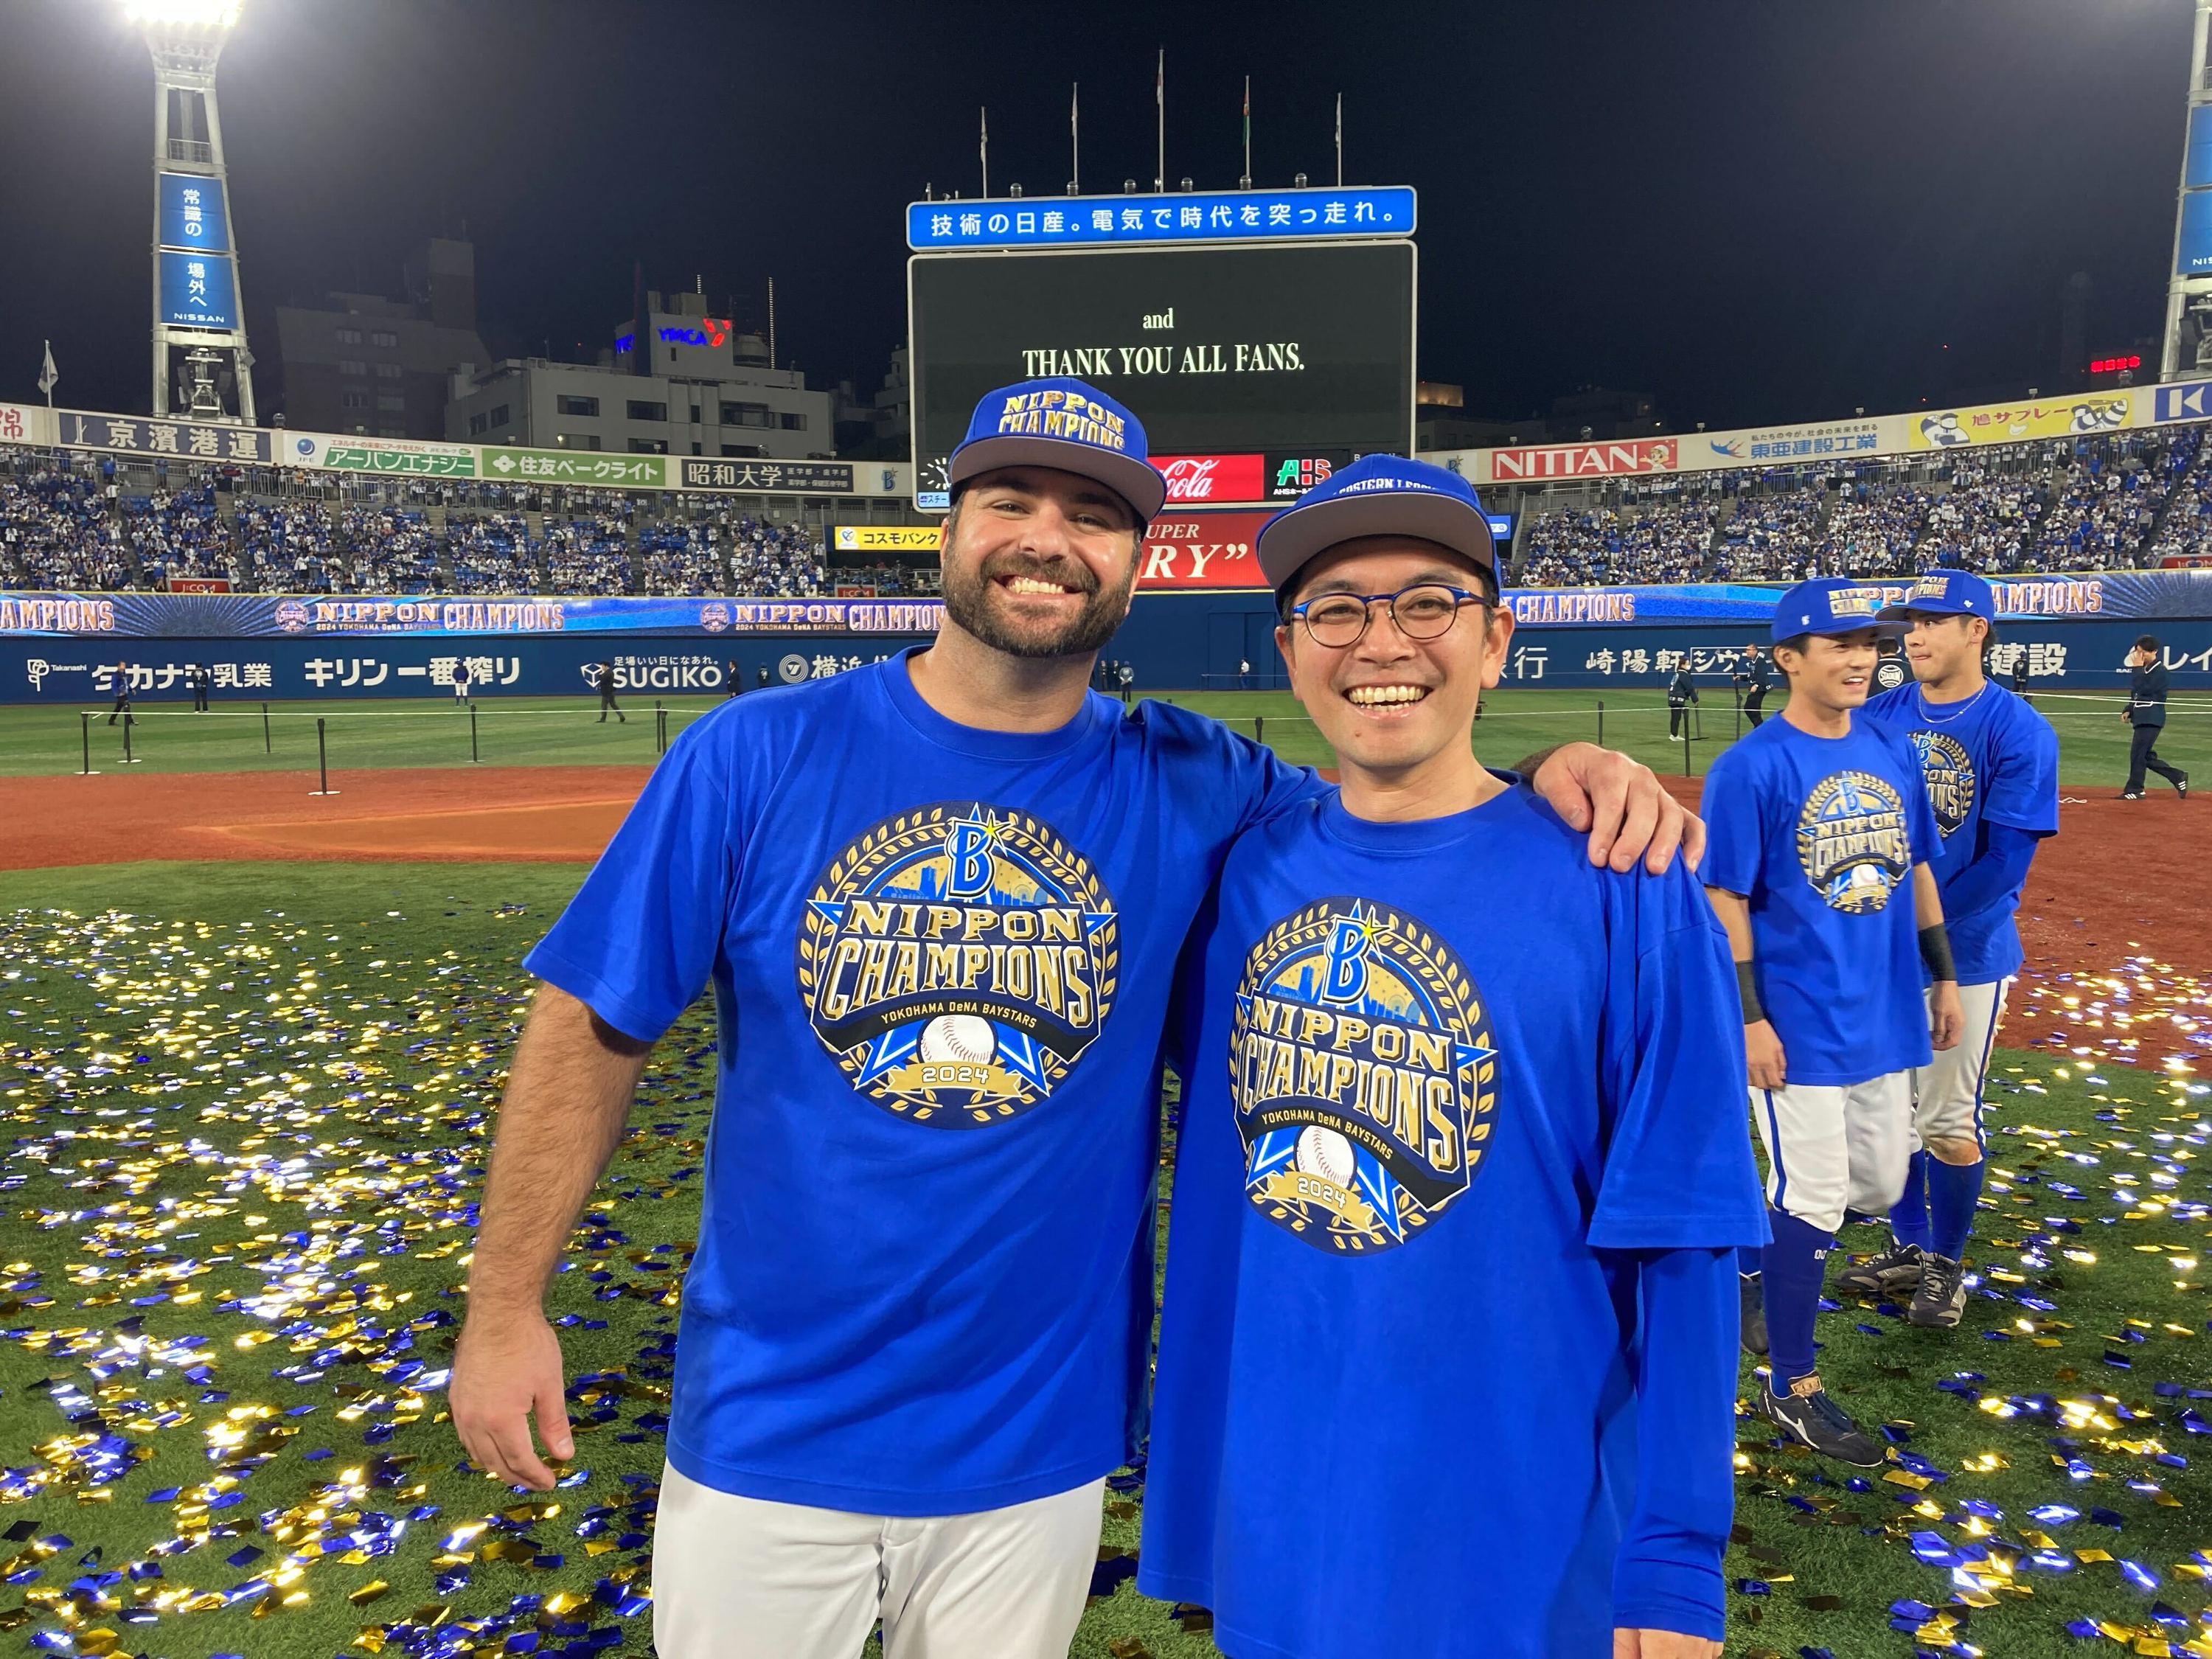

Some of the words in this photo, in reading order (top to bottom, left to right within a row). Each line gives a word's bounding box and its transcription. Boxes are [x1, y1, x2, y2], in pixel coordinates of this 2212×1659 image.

[183, 189, 203, 237] 常識の
[931, 201, 1395, 237] 技術の日産。電気で時代を突っ走れ。
[187, 262, 207, 307] 場外へ
[174, 313, 224, 323] NISSAN
[1142, 307, 1175, 330] and
[1022, 348, 1113, 378] THANK
[1118, 347, 1174, 375] YOU
[1179, 345, 1227, 372] ALL
[1236, 341, 1305, 372] FANS.
[1002, 390, 1125, 437] NIPPON
[1971, 407, 2068, 427] 鳩サブレー
[106, 420, 259, 459] 京濱港運
[1750, 434, 1878, 459] 東亜建設工業
[330, 448, 473, 473] アーバンエナジー
[519, 455, 658, 480] 住友ベークライト
[1496, 444, 1638, 478] NITTAN
[688, 463, 782, 487] 昭和大学
[863, 532, 939, 546] コスモバンク
[1144, 524, 1200, 539] UPER
[315, 602, 440, 622] NIPPON
[443, 603, 565, 630] CHAMPIONS
[735, 605, 847, 623] NIPPON
[849, 605, 947, 631] CHAMPION
[1516, 593, 1635, 622] CHAMPIONS
[51, 664, 87, 672] Takanashi
[614, 655, 719, 666] 足場いい日になあれ。
[1500, 646, 1548, 679] 行
[1983, 642, 2067, 677] 建設
[613, 666, 723, 688] SUGIKO
[1814, 813, 1898, 839] NIPPON
[841, 899, 1082, 942] NIPPON
[818, 938, 1094, 1029] CHAMPIONS
[880, 1001, 945, 1025] YOKOHAMA
[948, 1001, 978, 1014] DeNA
[981, 1002, 1037, 1029] BAYSTARS
[1248, 995, 1453, 1074] NIPPON
[922, 1065, 990, 1084] 2024
[1239, 1032, 1462, 1174] CHAMPIONS
[1261, 1110, 1315, 1126] YOKOHAMA
[1318, 1115, 1341, 1129] DeNA
[1344, 1122, 1394, 1161] BAYSTARS
[1296, 1176, 1348, 1209] 2024
